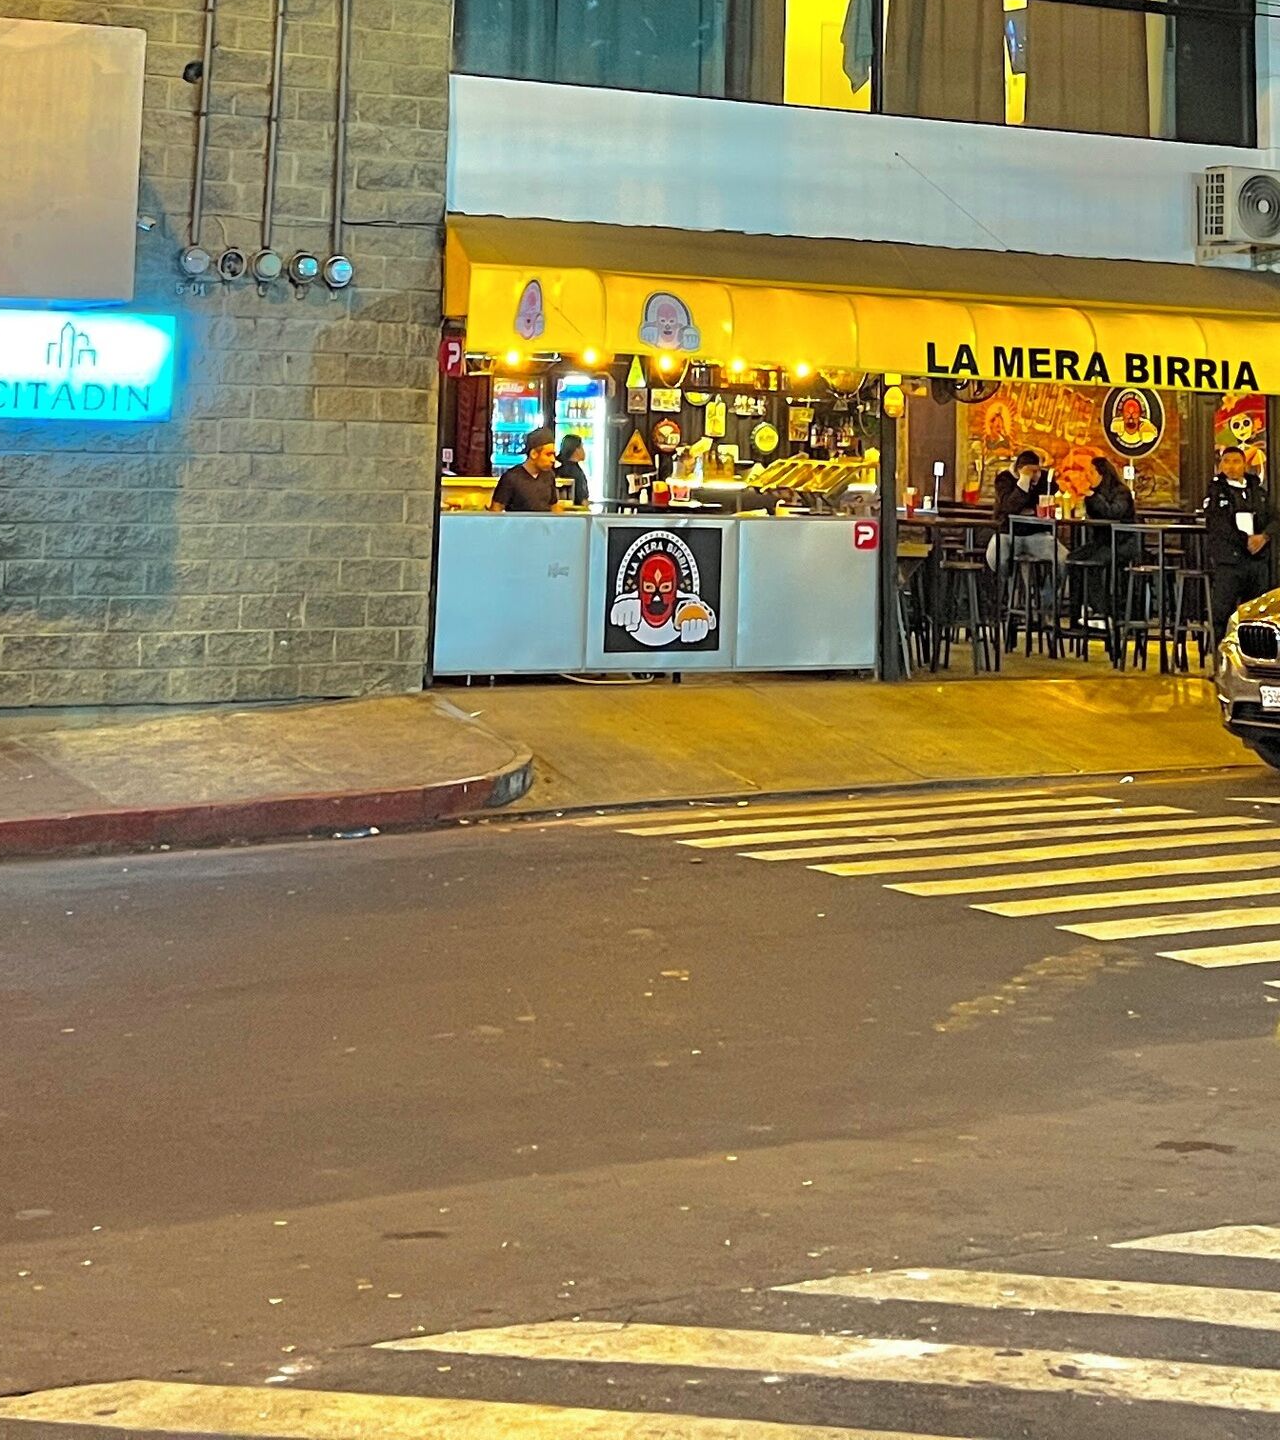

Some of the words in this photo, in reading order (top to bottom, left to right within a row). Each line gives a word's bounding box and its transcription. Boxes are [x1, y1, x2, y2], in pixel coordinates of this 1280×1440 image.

[175, 282, 206, 297] 5-01
[927, 342, 979, 376] LA
[993, 346, 1110, 383] MERA
[1125, 353, 1259, 391] BIRRIA
[627, 562, 639, 576] LA
[637, 541, 664, 560] MERA
[666, 542, 690, 576] BIRRIA
